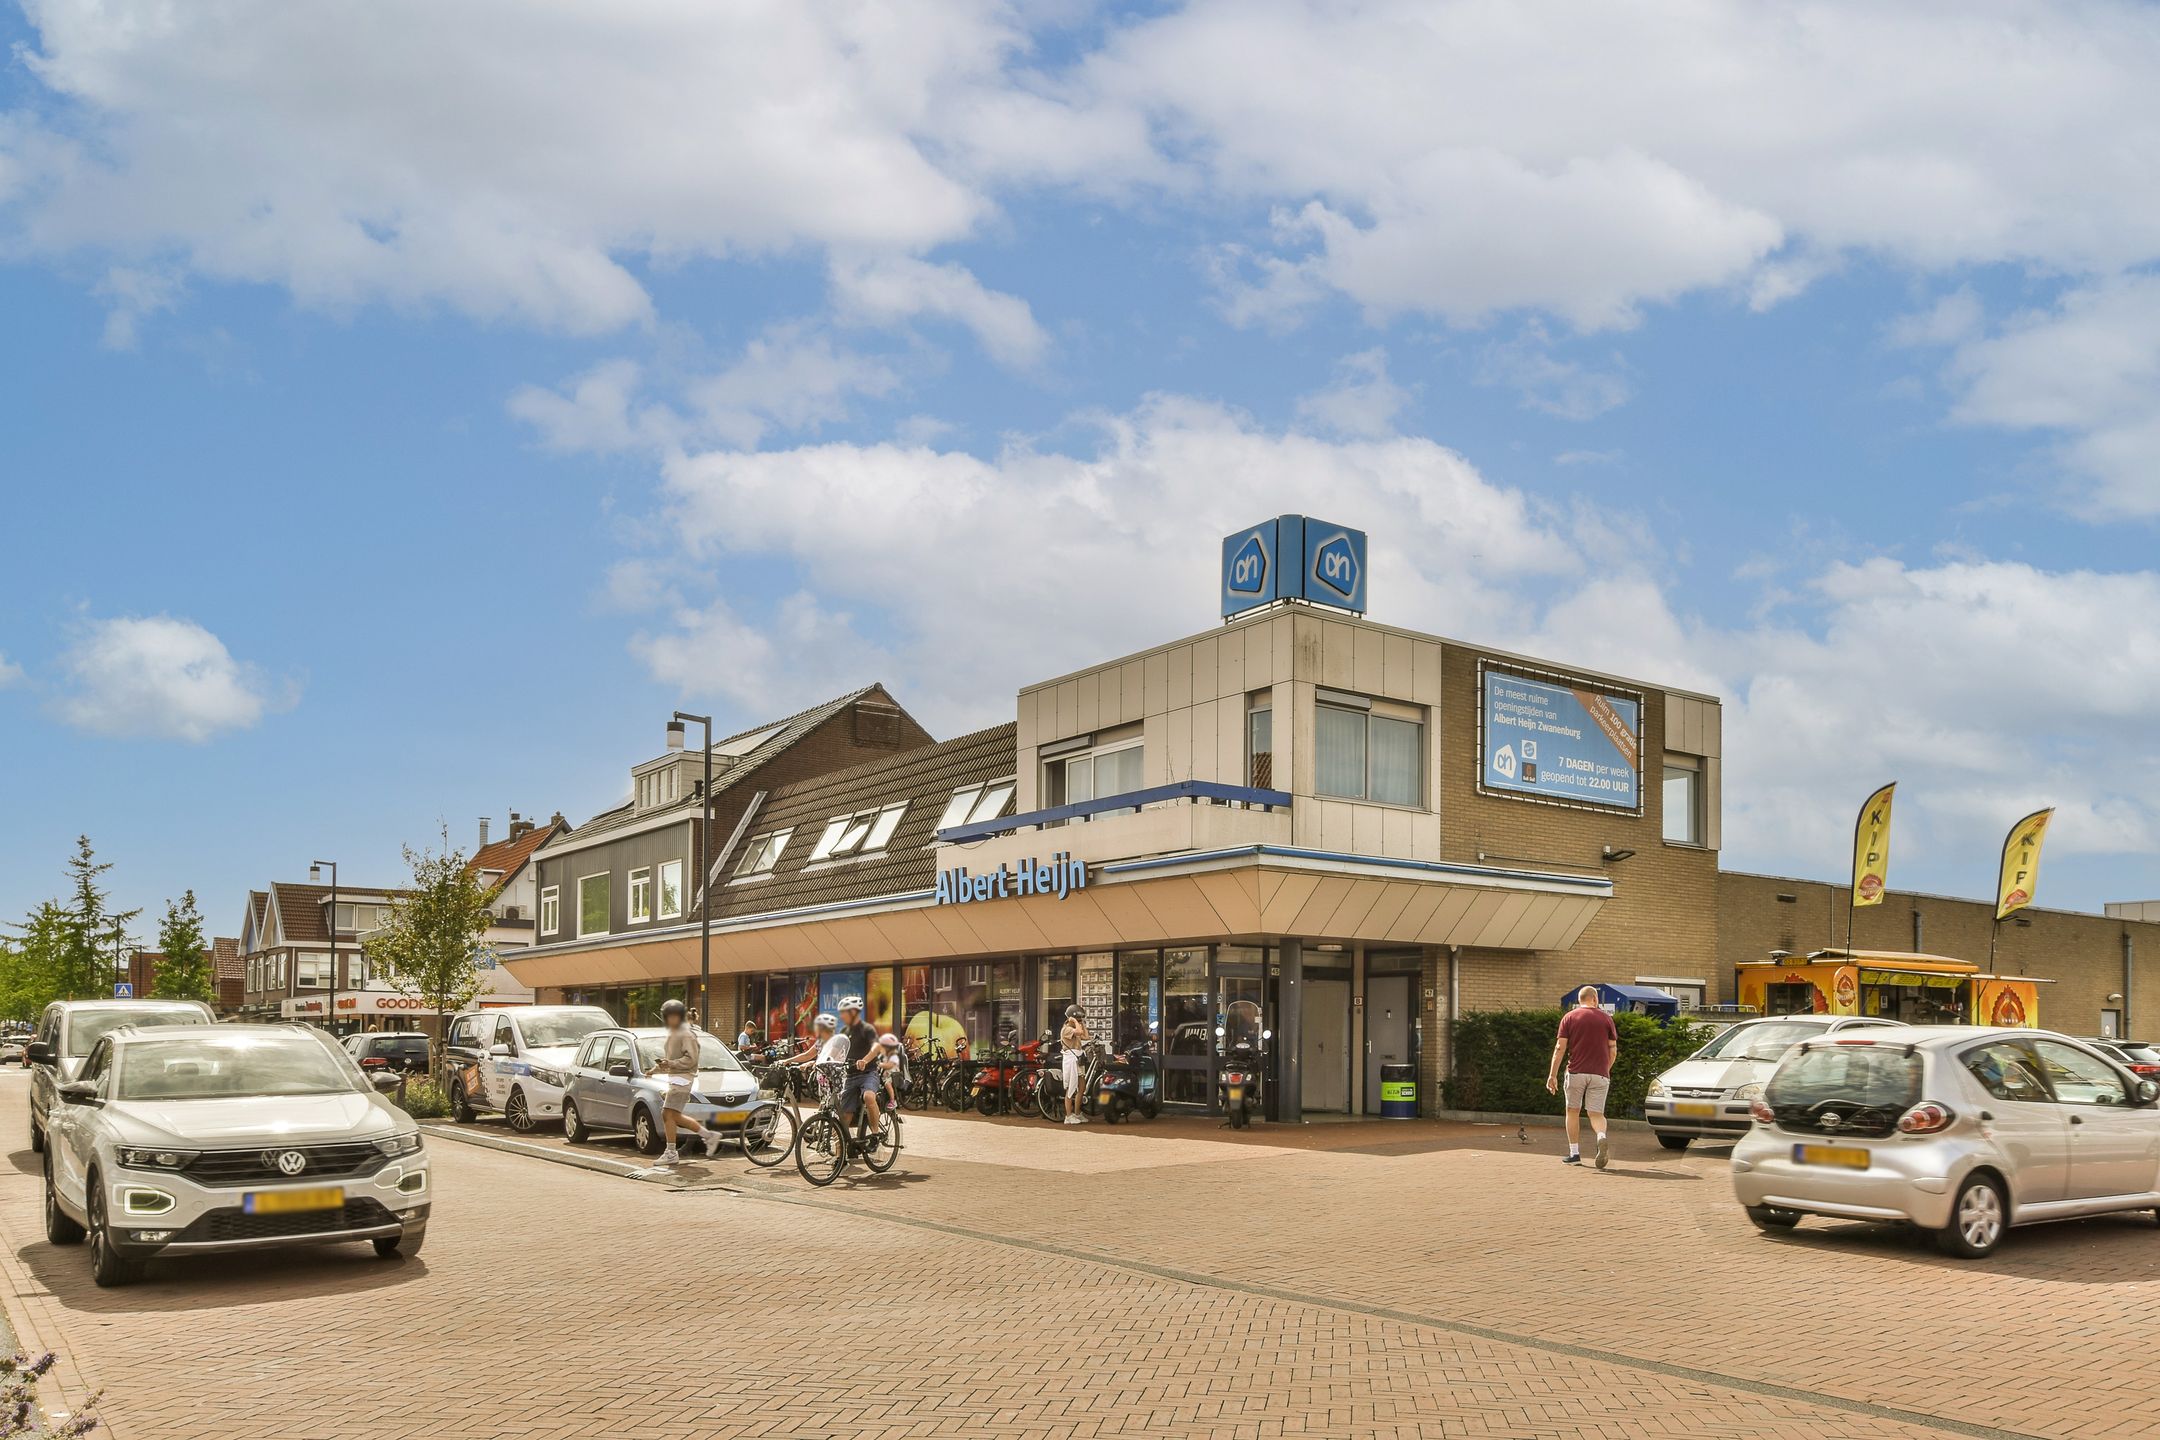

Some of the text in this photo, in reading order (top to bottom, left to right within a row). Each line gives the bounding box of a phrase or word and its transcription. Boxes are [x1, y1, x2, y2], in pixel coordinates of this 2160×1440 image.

[1494, 686, 1549, 705] De meest ruime
[1494, 701, 1558, 721] openingstijden van
[1595, 695, 1611, 716] Ruim
[1610, 713, 1622, 729] 100
[1494, 713, 1581, 740] Albert Heijn Zwanenburg
[1589, 705, 1632, 759] parkeerplaatsen
[1558, 757, 1630, 778] 7 DAGEN per week
[1541, 770, 1575, 784] geopend
[1576, 774, 1588, 784] tot
[1588, 777, 1611, 790] 22.00
[1612, 780, 1630, 793] UUR
[1867, 809, 1882, 868] KIP
[935, 851, 1088, 905] Albert Heijn
